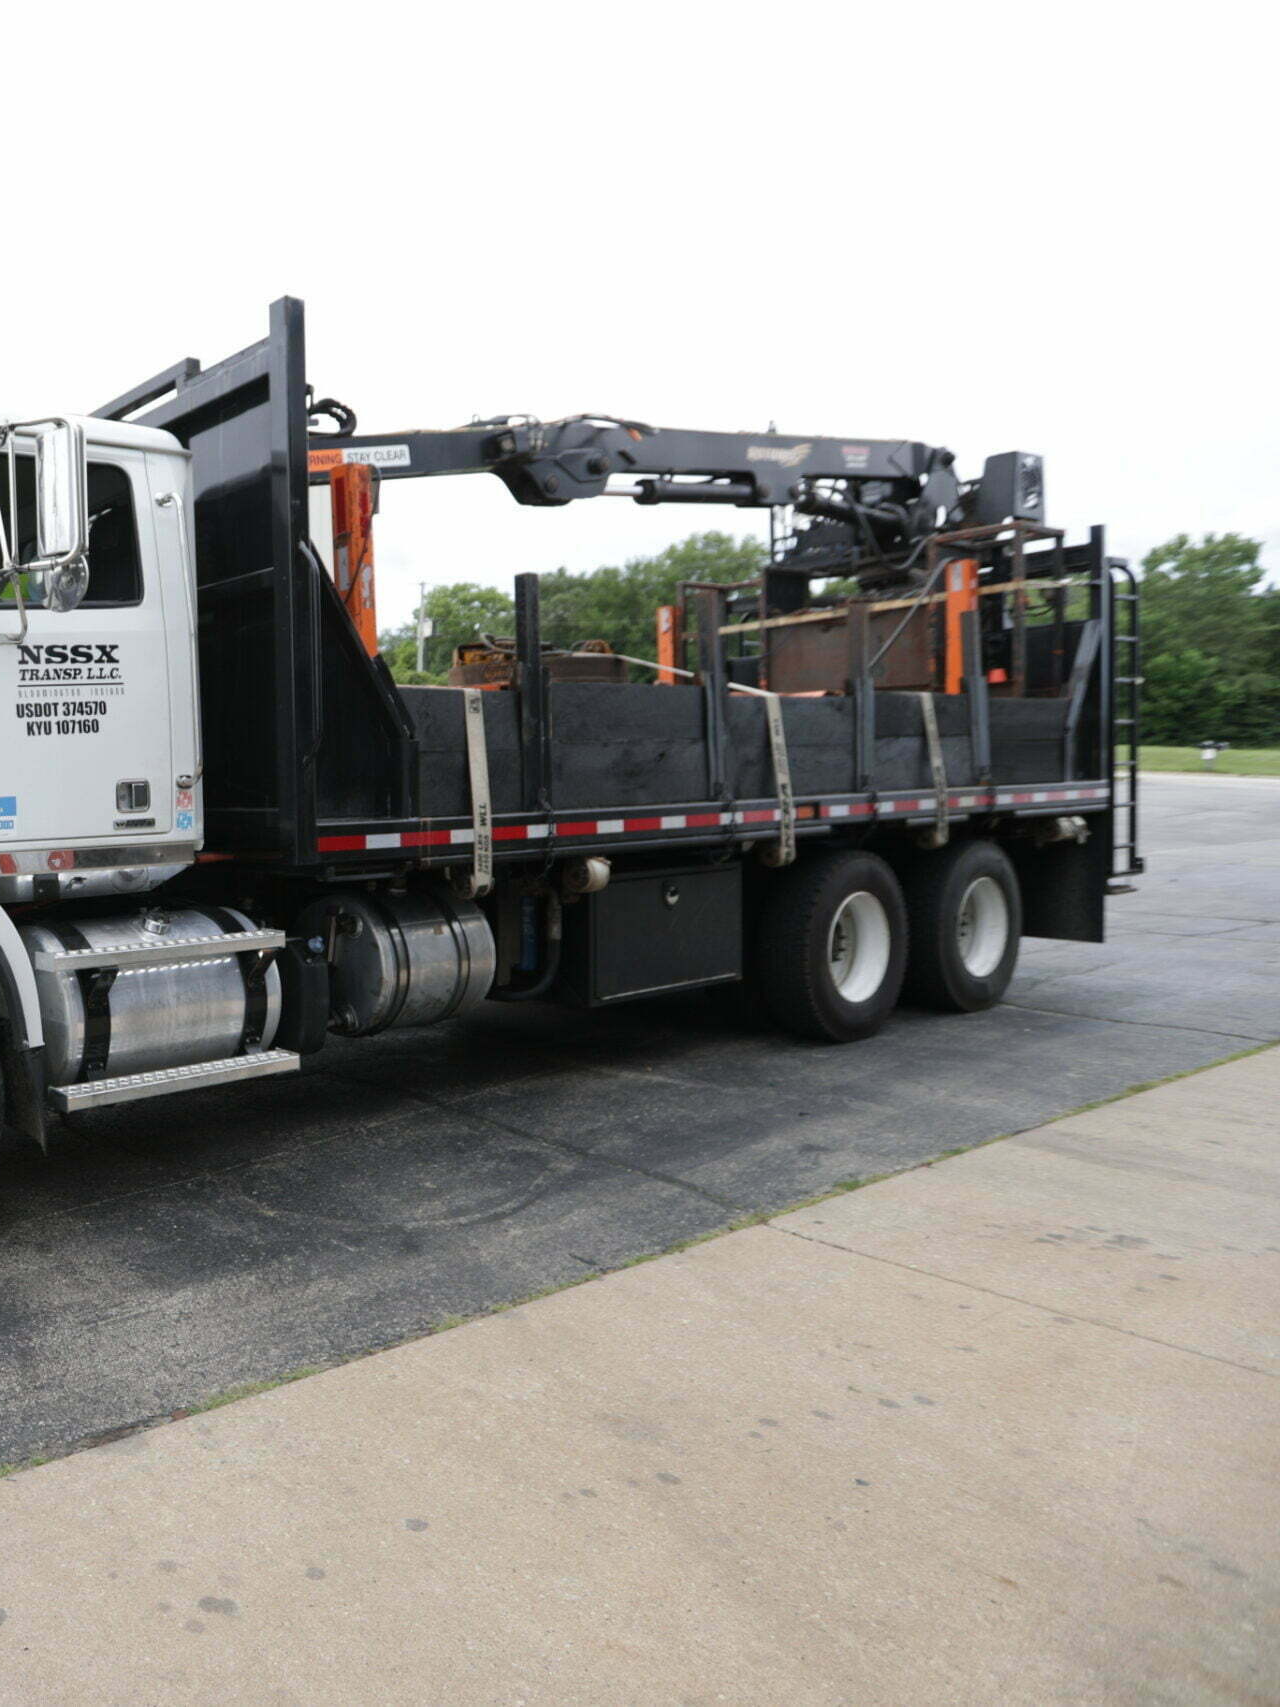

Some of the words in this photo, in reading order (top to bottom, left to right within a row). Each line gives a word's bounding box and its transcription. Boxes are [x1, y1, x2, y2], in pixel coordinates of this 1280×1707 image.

[346, 451, 370, 464] STAY
[373, 449, 407, 461] CLEAR
[17, 644, 120, 665] NSSX
[19, 668, 84, 681] TRANSP.
[86, 667, 123, 680] L.L.C.
[16, 702, 59, 719] USDOT
[61, 700, 107, 717] 374570
[26, 720, 52, 737] KYU
[54, 718, 100, 735] 107160
